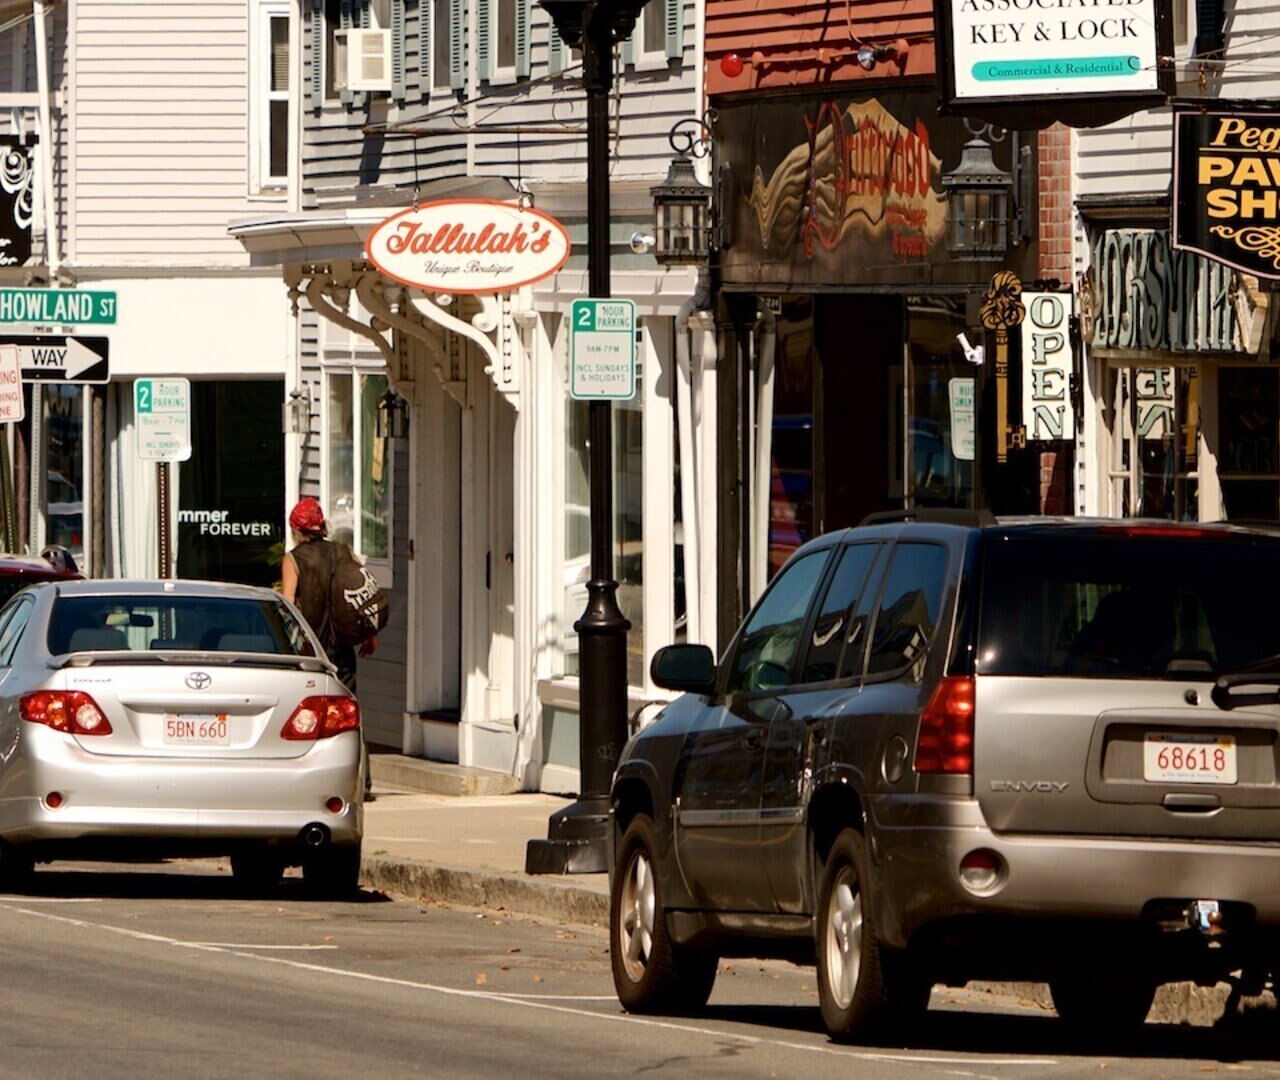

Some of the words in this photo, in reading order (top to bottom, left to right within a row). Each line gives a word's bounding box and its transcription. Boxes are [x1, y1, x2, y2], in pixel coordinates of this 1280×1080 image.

[970, 22, 1025, 44] KEY
[1034, 21, 1051, 42] &
[1061, 18, 1139, 40] LOCK
[988, 61, 1052, 78] Commercial
[1053, 62, 1063, 74] &
[1065, 59, 1123, 74] Residential
[386, 221, 552, 255] Tallulah's
[424, 260, 460, 278] Unique
[463, 260, 514, 278] Boutique
[0, 293, 93, 321] HOWLAND
[99, 298, 115, 317] ST
[603, 306, 625, 316] HOUR
[578, 307, 592, 327] 2
[598, 317, 630, 328] PARKING
[31, 348, 68, 366] WAY
[595, 364, 630, 372] SUNDAYS
[1030, 295, 1066, 440] OPEN
[589, 373, 625, 382] HOLIDAYS
[139, 386, 150, 409] 2
[153, 397, 185, 408] PARKING
[178, 509, 229, 523] mmer
[200, 522, 271, 536] FOREVER
[167, 720, 195, 738] 5BN
[199, 721, 227, 738] 660
[1157, 746, 1225, 772] 68618
[990, 780, 1070, 793] ENVOY
